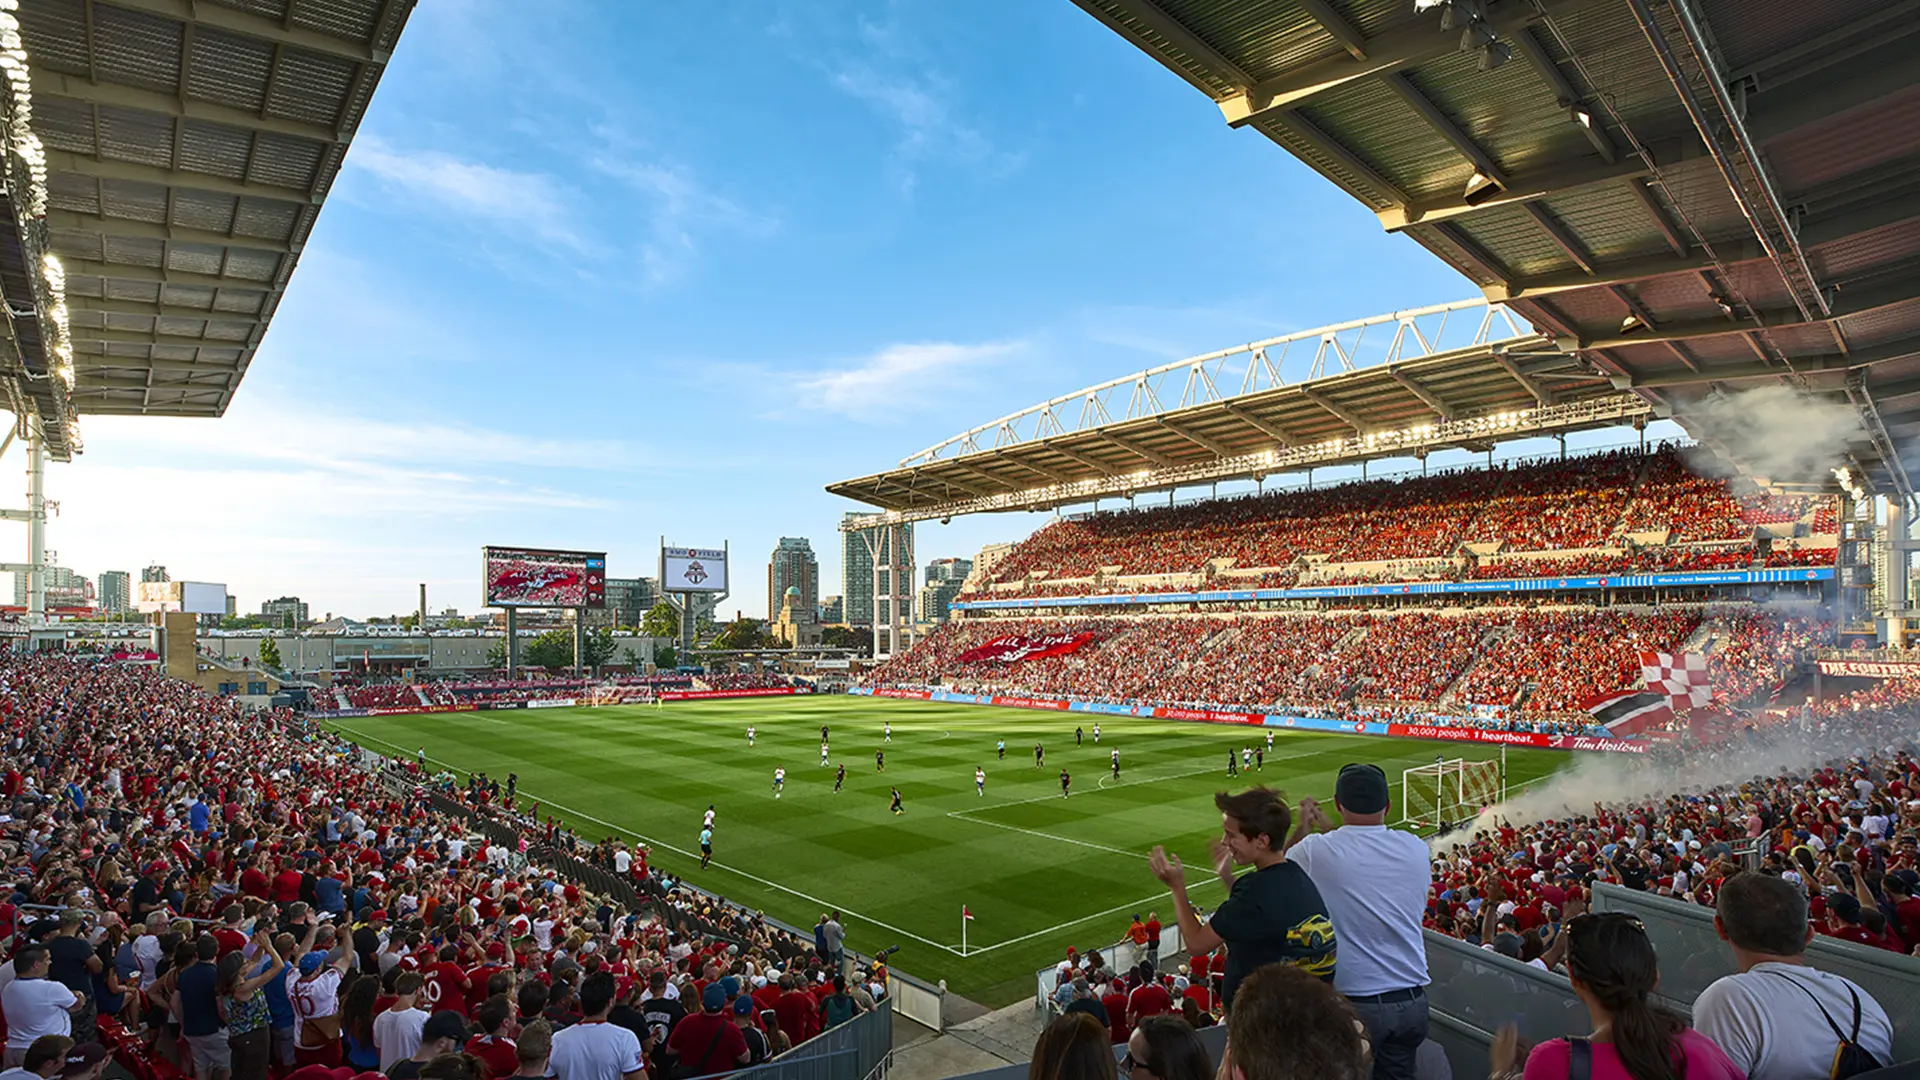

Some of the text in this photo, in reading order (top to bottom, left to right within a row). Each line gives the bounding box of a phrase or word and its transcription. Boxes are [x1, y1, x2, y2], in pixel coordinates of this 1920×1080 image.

[1820, 662, 1920, 677] THE FORTRES
[1407, 726, 1437, 736] 30,000
[1437, 728, 1471, 739] people.
[1482, 731, 1534, 744] heartbeat.
[1573, 737, 1643, 753] Tim Hortons
